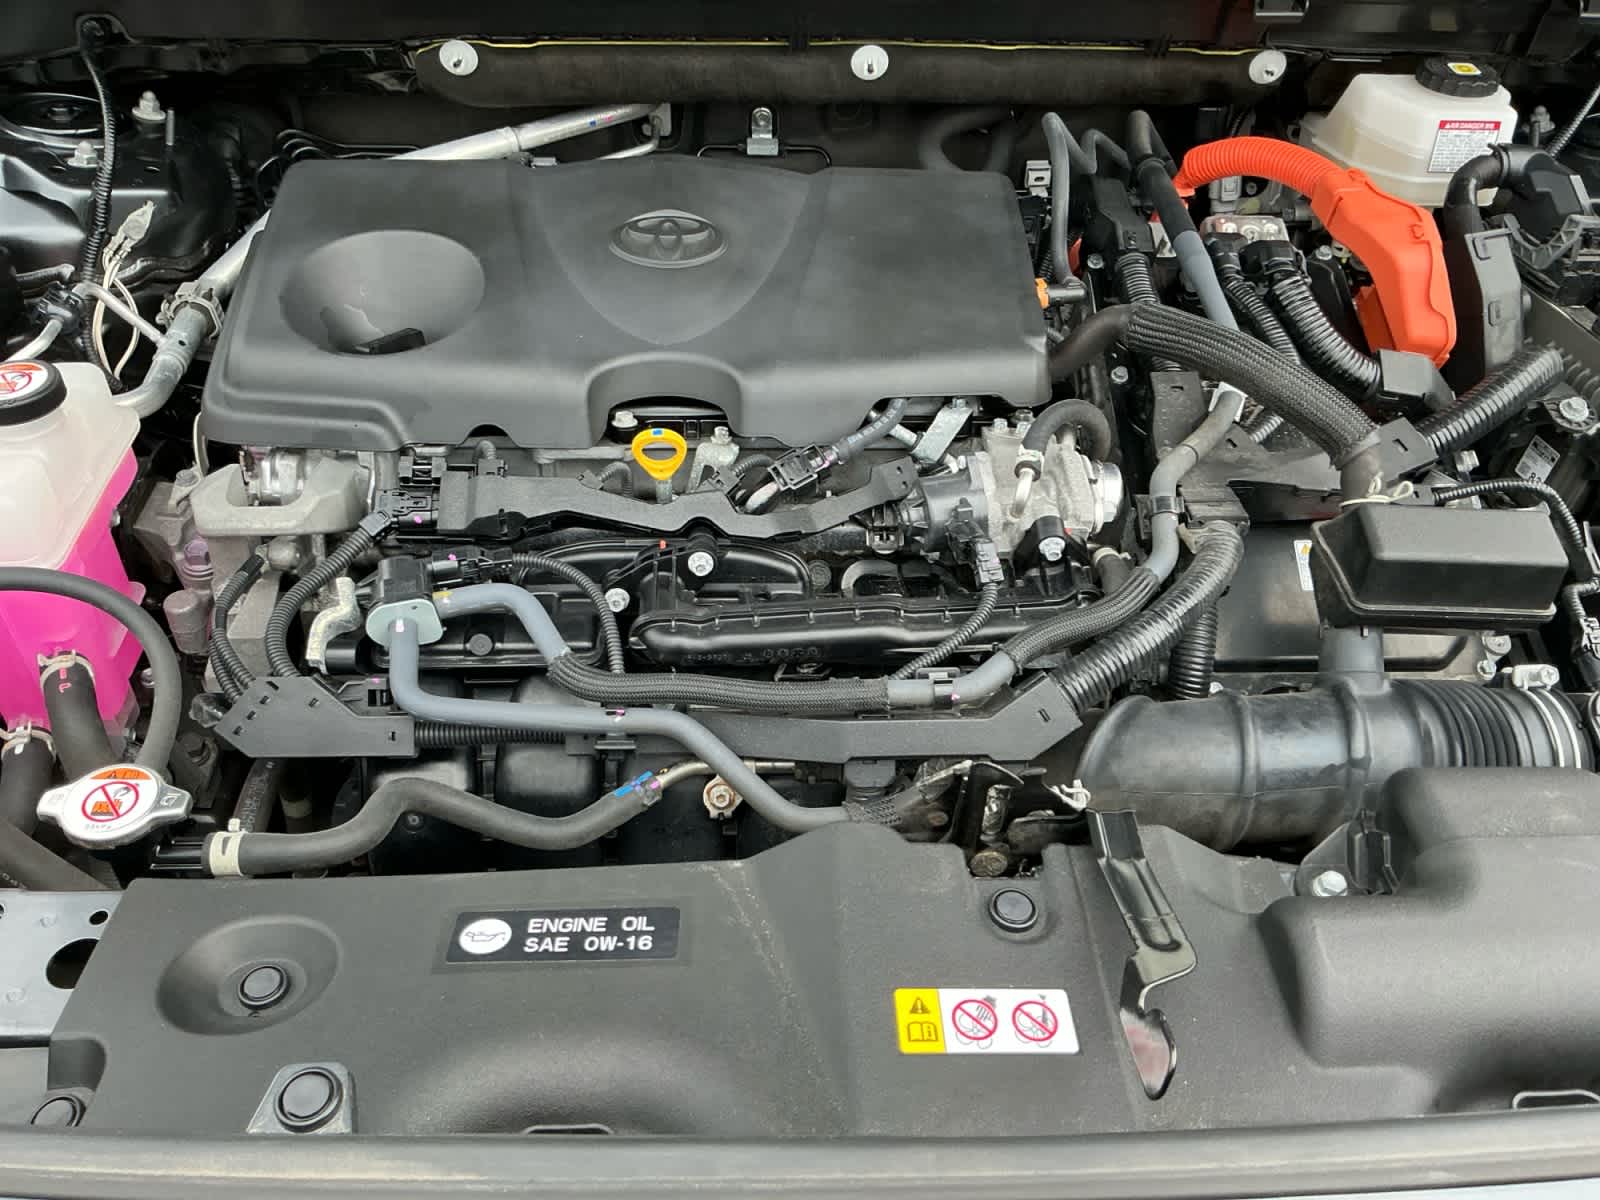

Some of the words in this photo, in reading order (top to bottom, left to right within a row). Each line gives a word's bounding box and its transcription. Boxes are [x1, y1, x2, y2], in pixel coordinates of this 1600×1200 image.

[527, 917, 608, 933] ENGINE
[621, 916, 655, 931] OIL
[523, 936, 570, 952] SAE
[584, 935, 653, 951] 0W-16
